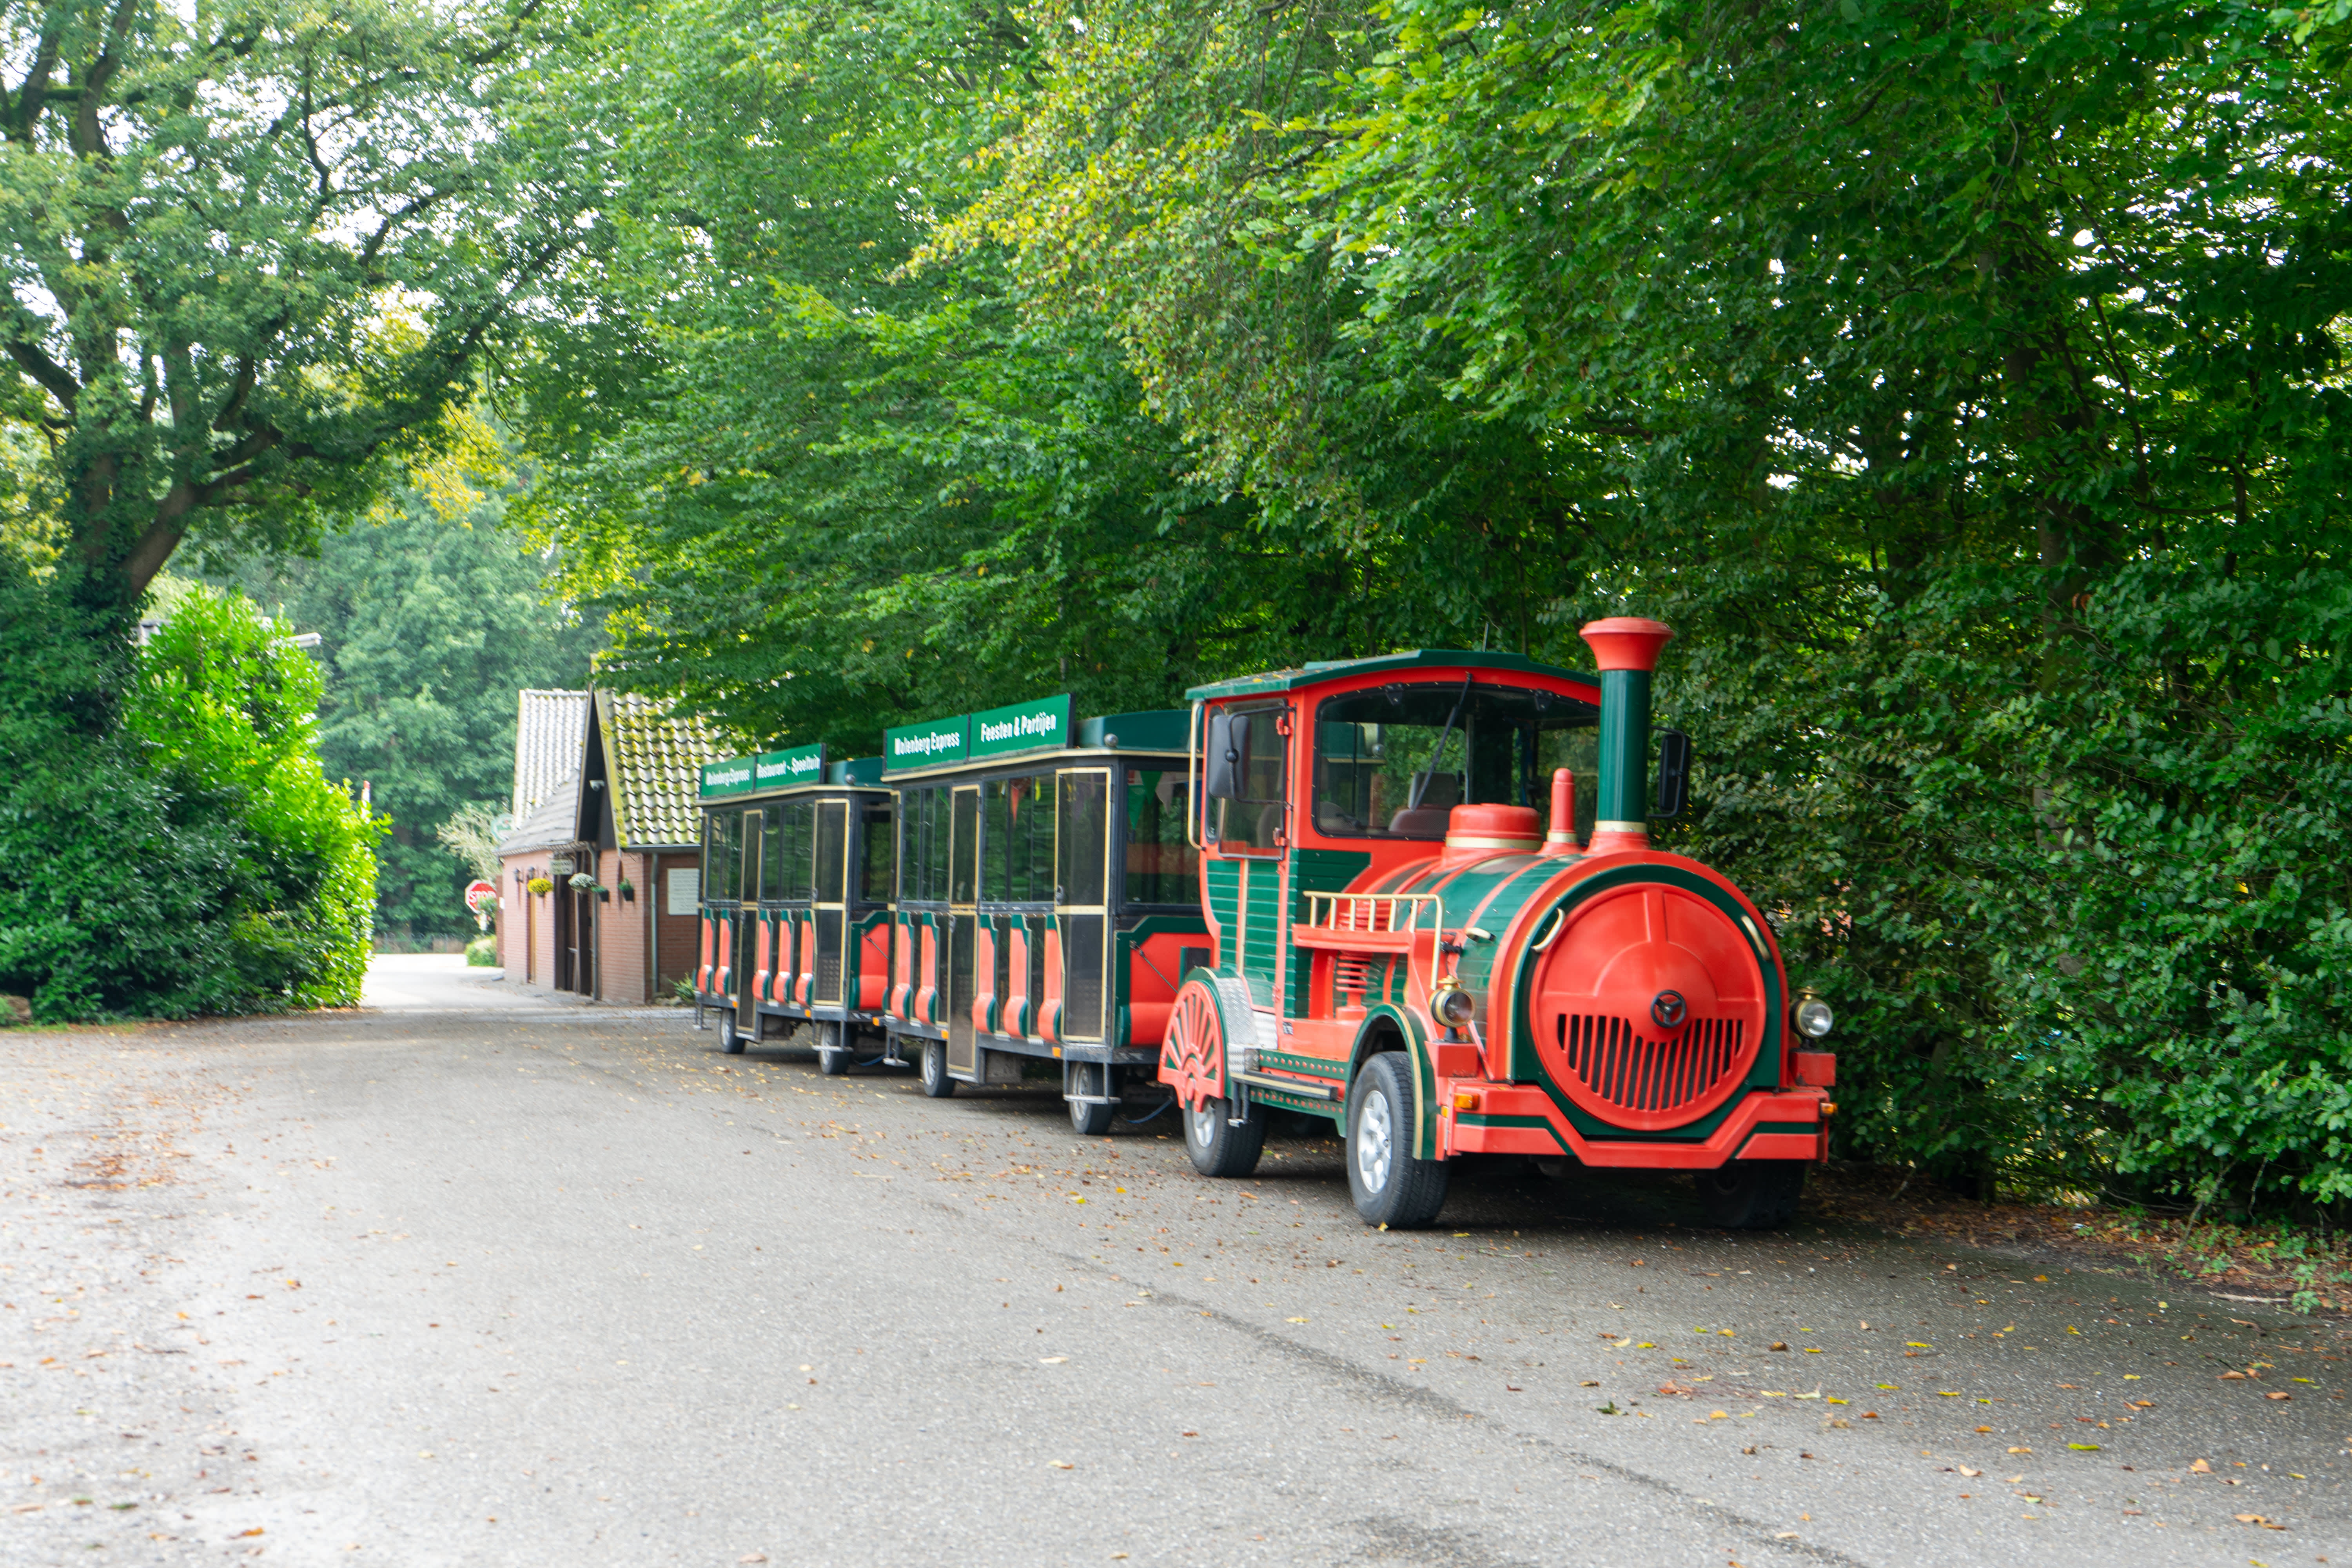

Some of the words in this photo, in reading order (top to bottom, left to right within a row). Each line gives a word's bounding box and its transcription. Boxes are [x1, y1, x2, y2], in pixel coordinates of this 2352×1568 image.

[981, 720, 1013, 742] Feesten
[1013, 717, 1020, 737] &
[1021, 711, 1056, 737] Partijen
[931, 731, 960, 753] Express
